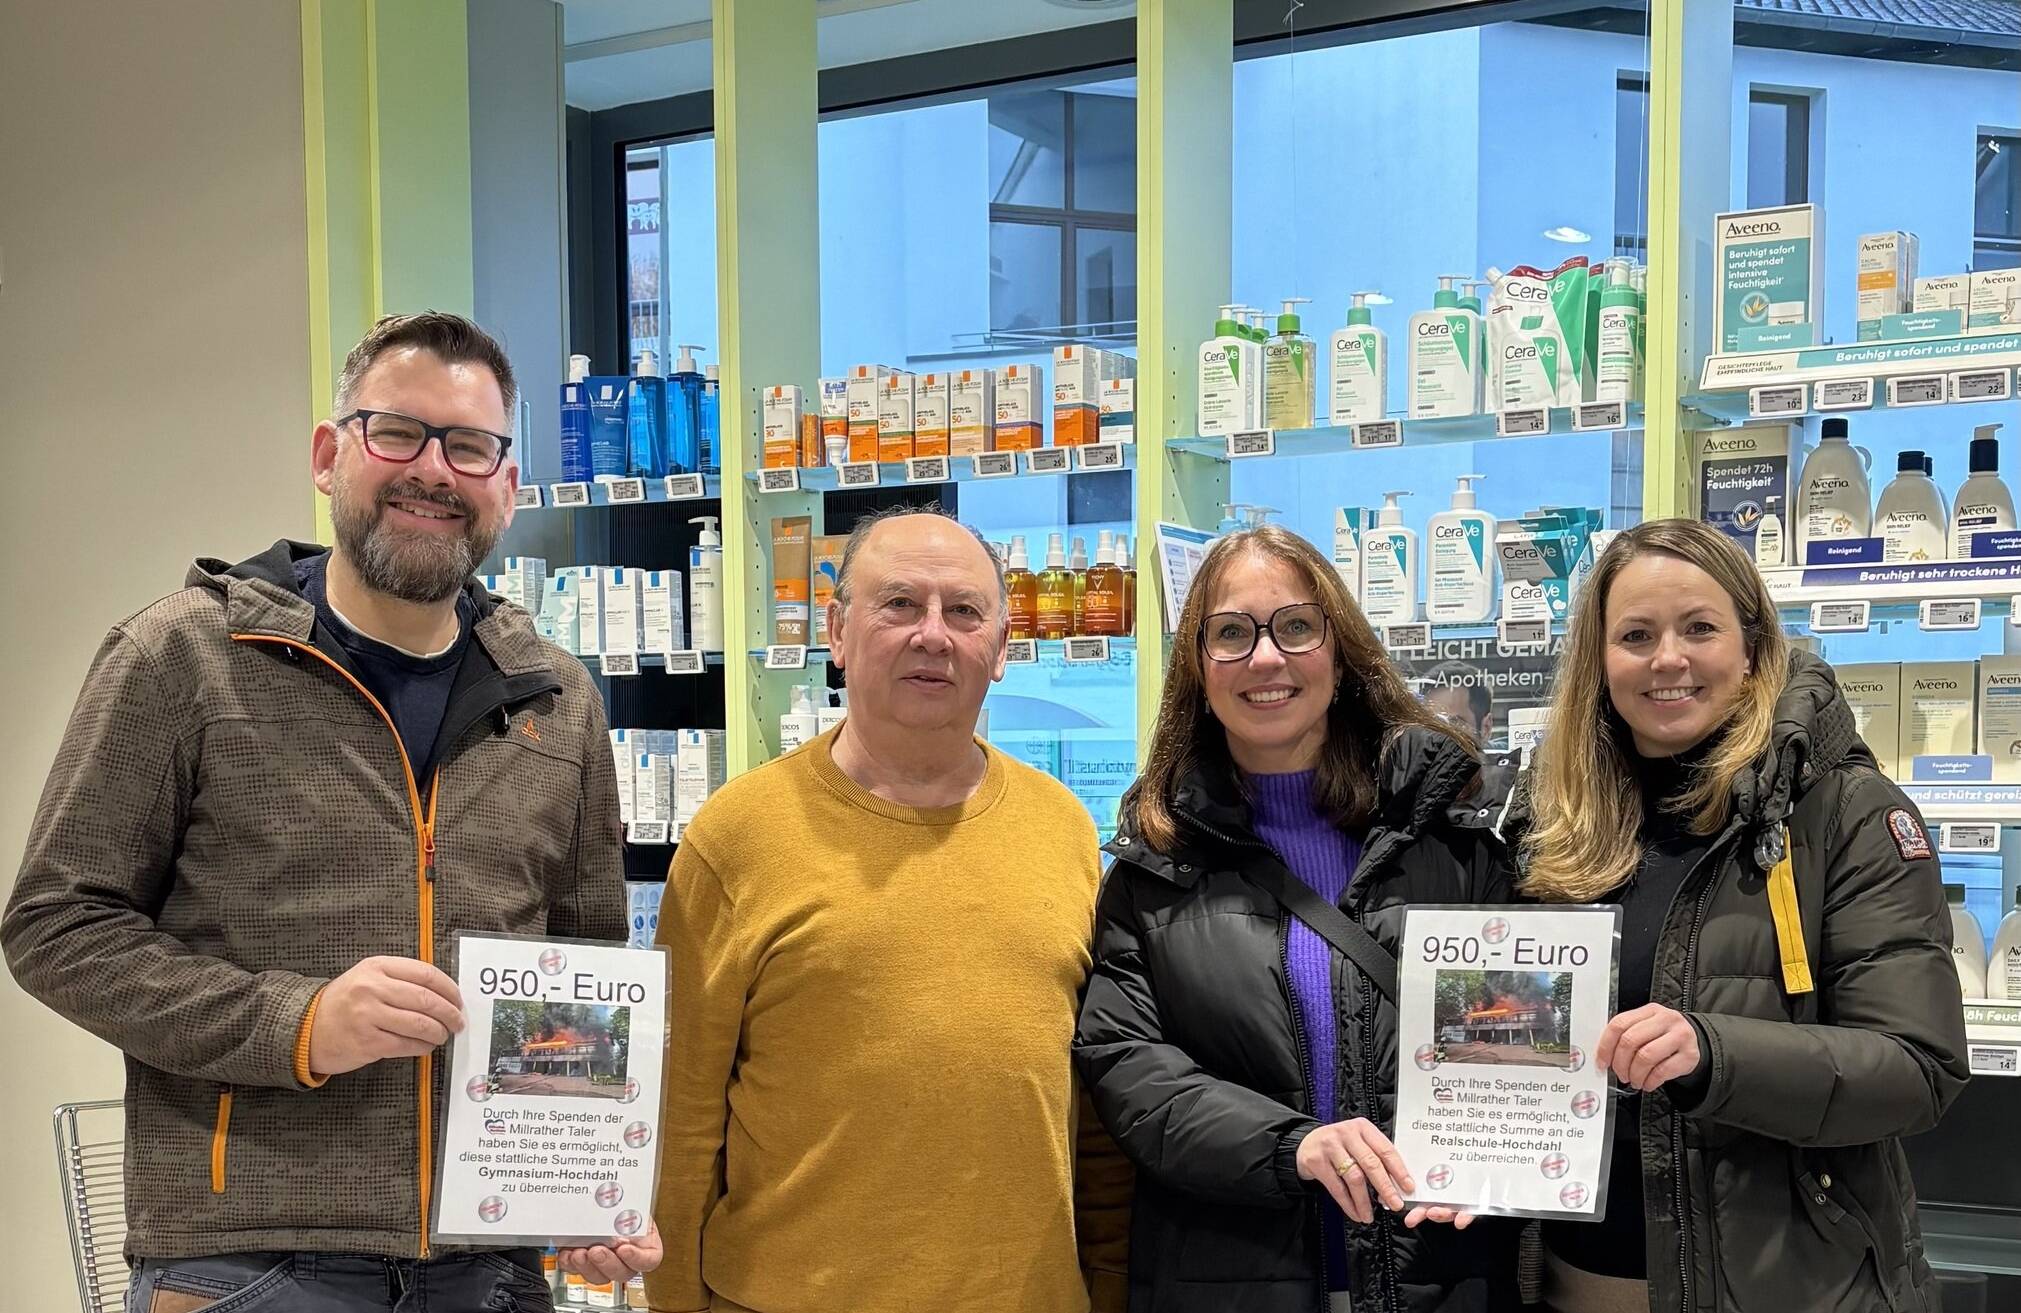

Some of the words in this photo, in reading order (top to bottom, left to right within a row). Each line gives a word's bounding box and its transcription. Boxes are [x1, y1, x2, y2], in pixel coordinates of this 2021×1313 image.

[1730, 248, 1768, 259] Beruhigt
[1769, 245, 1795, 255] sofort
[1862, 242, 1894, 252] Aveeno
[1729, 260, 1746, 269] und
[1748, 257, 1784, 269] spendet
[1729, 269, 1768, 279] intensive
[1982, 275, 2016, 285] Aveeno
[1506, 280, 1566, 300] CeraVe
[1925, 282, 1958, 290] Aveeno
[1418, 321, 1466, 336] CeraVe
[1603, 318, 1636, 329] CeraVe
[1337, 338, 1374, 350] CeraVe
[1758, 333, 1792, 342] Reinigend
[1204, 349, 1238, 362] CeraVe
[1266, 344, 1302, 356] CeraVe
[1506, 342, 1556, 359] CeraVe
[1836, 348, 1892, 362] Beruhigt
[1895, 345, 1932, 358] sofort
[1936, 342, 1962, 354] und
[1964, 338, 2018, 353] spendet
[1707, 465, 1751, 479] Spendet
[1754, 463, 1773, 474] 72h
[1810, 480, 1849, 490] Aveeno
[1887, 512, 1926, 522] Aveeno
[1958, 506, 1997, 516] Aveeno
[1436, 524, 1480, 538] CeraVe
[1368, 540, 1405, 551] CeraVe
[1503, 544, 1557, 558] CeraVe
[1828, 546, 1862, 556] Reinigend
[1860, 570, 1916, 582] Beruhigt
[1918, 569, 1946, 579] sehr
[1950, 566, 2007, 578] trockene
[1511, 583, 1560, 600] CeraVe
[1411, 639, 1492, 660] LEICHT
[1435, 668, 1554, 692] Apotheken-
[1914, 680, 1958, 690] Aveeno
[1987, 675, 2021, 684] Aveen
[1842, 682, 1884, 692] Aveeno
[1935, 790, 1982, 800] schützt
[1423, 936, 1502, 968] 950,-
[1514, 938, 1588, 966] Euro
[480, 967, 561, 1002] 950,-
[574, 972, 646, 1004] Euro
[1431, 1076, 1466, 1088] Durch
[1469, 1078, 1491, 1090] Ihre
[1494, 1080, 1547, 1093] Spenden
[1550, 1082, 1570, 1093] der
[1457, 1092, 1510, 1105] Millrather
[1514, 1094, 1542, 1106] Taler
[483, 1108, 519, 1120] Durch
[522, 1109, 546, 1121] Ihre
[549, 1110, 600, 1124] Spenden
[604, 1112, 624, 1124] der
[1428, 1106, 1462, 1118] haben
[1466, 1108, 1486, 1118] Sie
[1488, 1110, 1502, 1120] es
[1506, 1110, 1570, 1124] ermöglicht,
[510, 1123, 564, 1136] Millrather
[567, 1126, 596, 1137] Taler
[1412, 1120, 1442, 1131] diese
[1446, 1122, 1496, 1134] stattliche
[1500, 1124, 1544, 1136] Summe
[1548, 1128, 1563, 1137] an
[1566, 1126, 1584, 1138] die
[478, 1138, 516, 1150] haben
[519, 1138, 538, 1150] Sie
[542, 1142, 556, 1150] es
[559, 1141, 623, 1154] ermöglicht,
[1431, 1136, 1562, 1152] Realschule-Hochdahl
[459, 1152, 492, 1162] diese
[496, 1153, 548, 1164] stattliche
[552, 1155, 596, 1166] Summe
[600, 1158, 614, 1167] an
[618, 1156, 638, 1168] das
[1450, 1152, 1464, 1162] zu
[1466, 1152, 1538, 1165] überreichen.
[478, 1166, 618, 1182] Gymnasium-Hochdahl
[501, 1184, 516, 1193] zu
[520, 1183, 592, 1195] überreichen.
